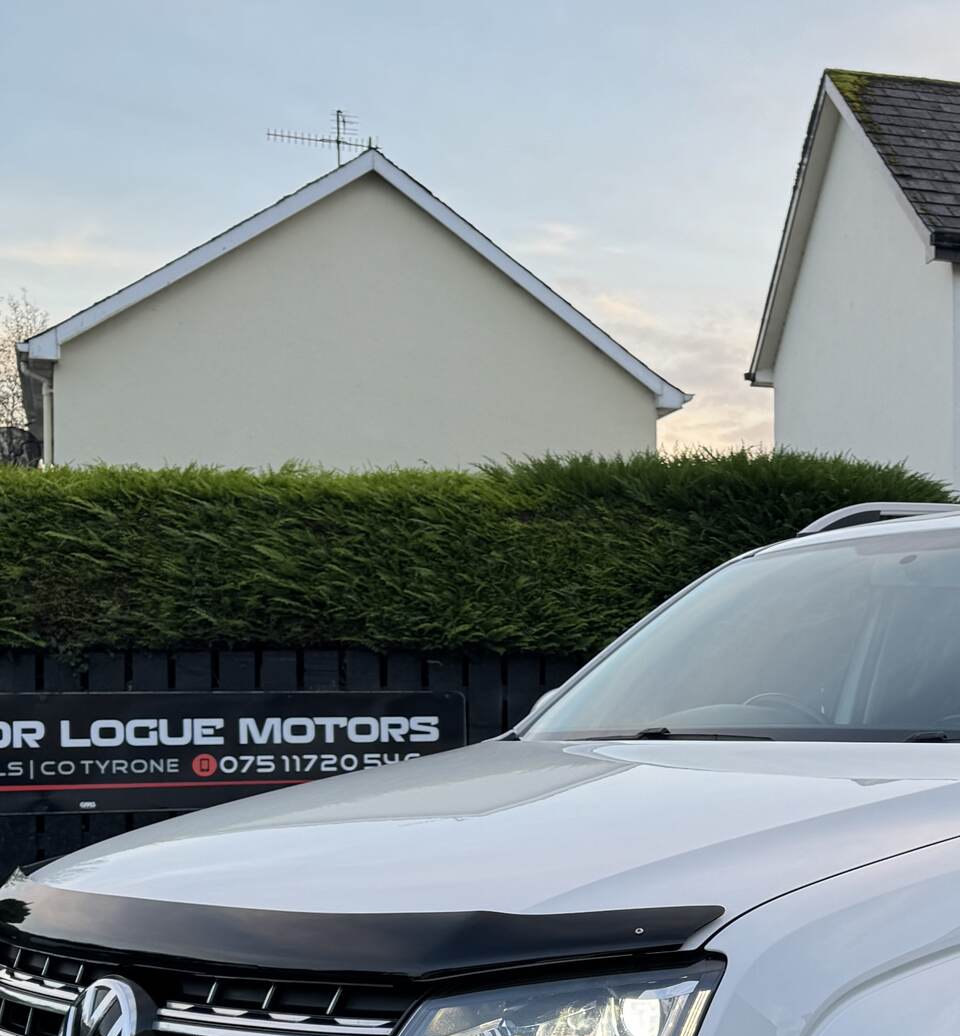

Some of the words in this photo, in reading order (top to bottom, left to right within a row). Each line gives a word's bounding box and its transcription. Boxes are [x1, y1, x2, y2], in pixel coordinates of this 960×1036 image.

[60, 718, 224, 747] LOGUE
[238, 716, 440, 744] MOTORS
[40, 761, 75, 775] CO
[80, 758, 180, 774] TYRONE
